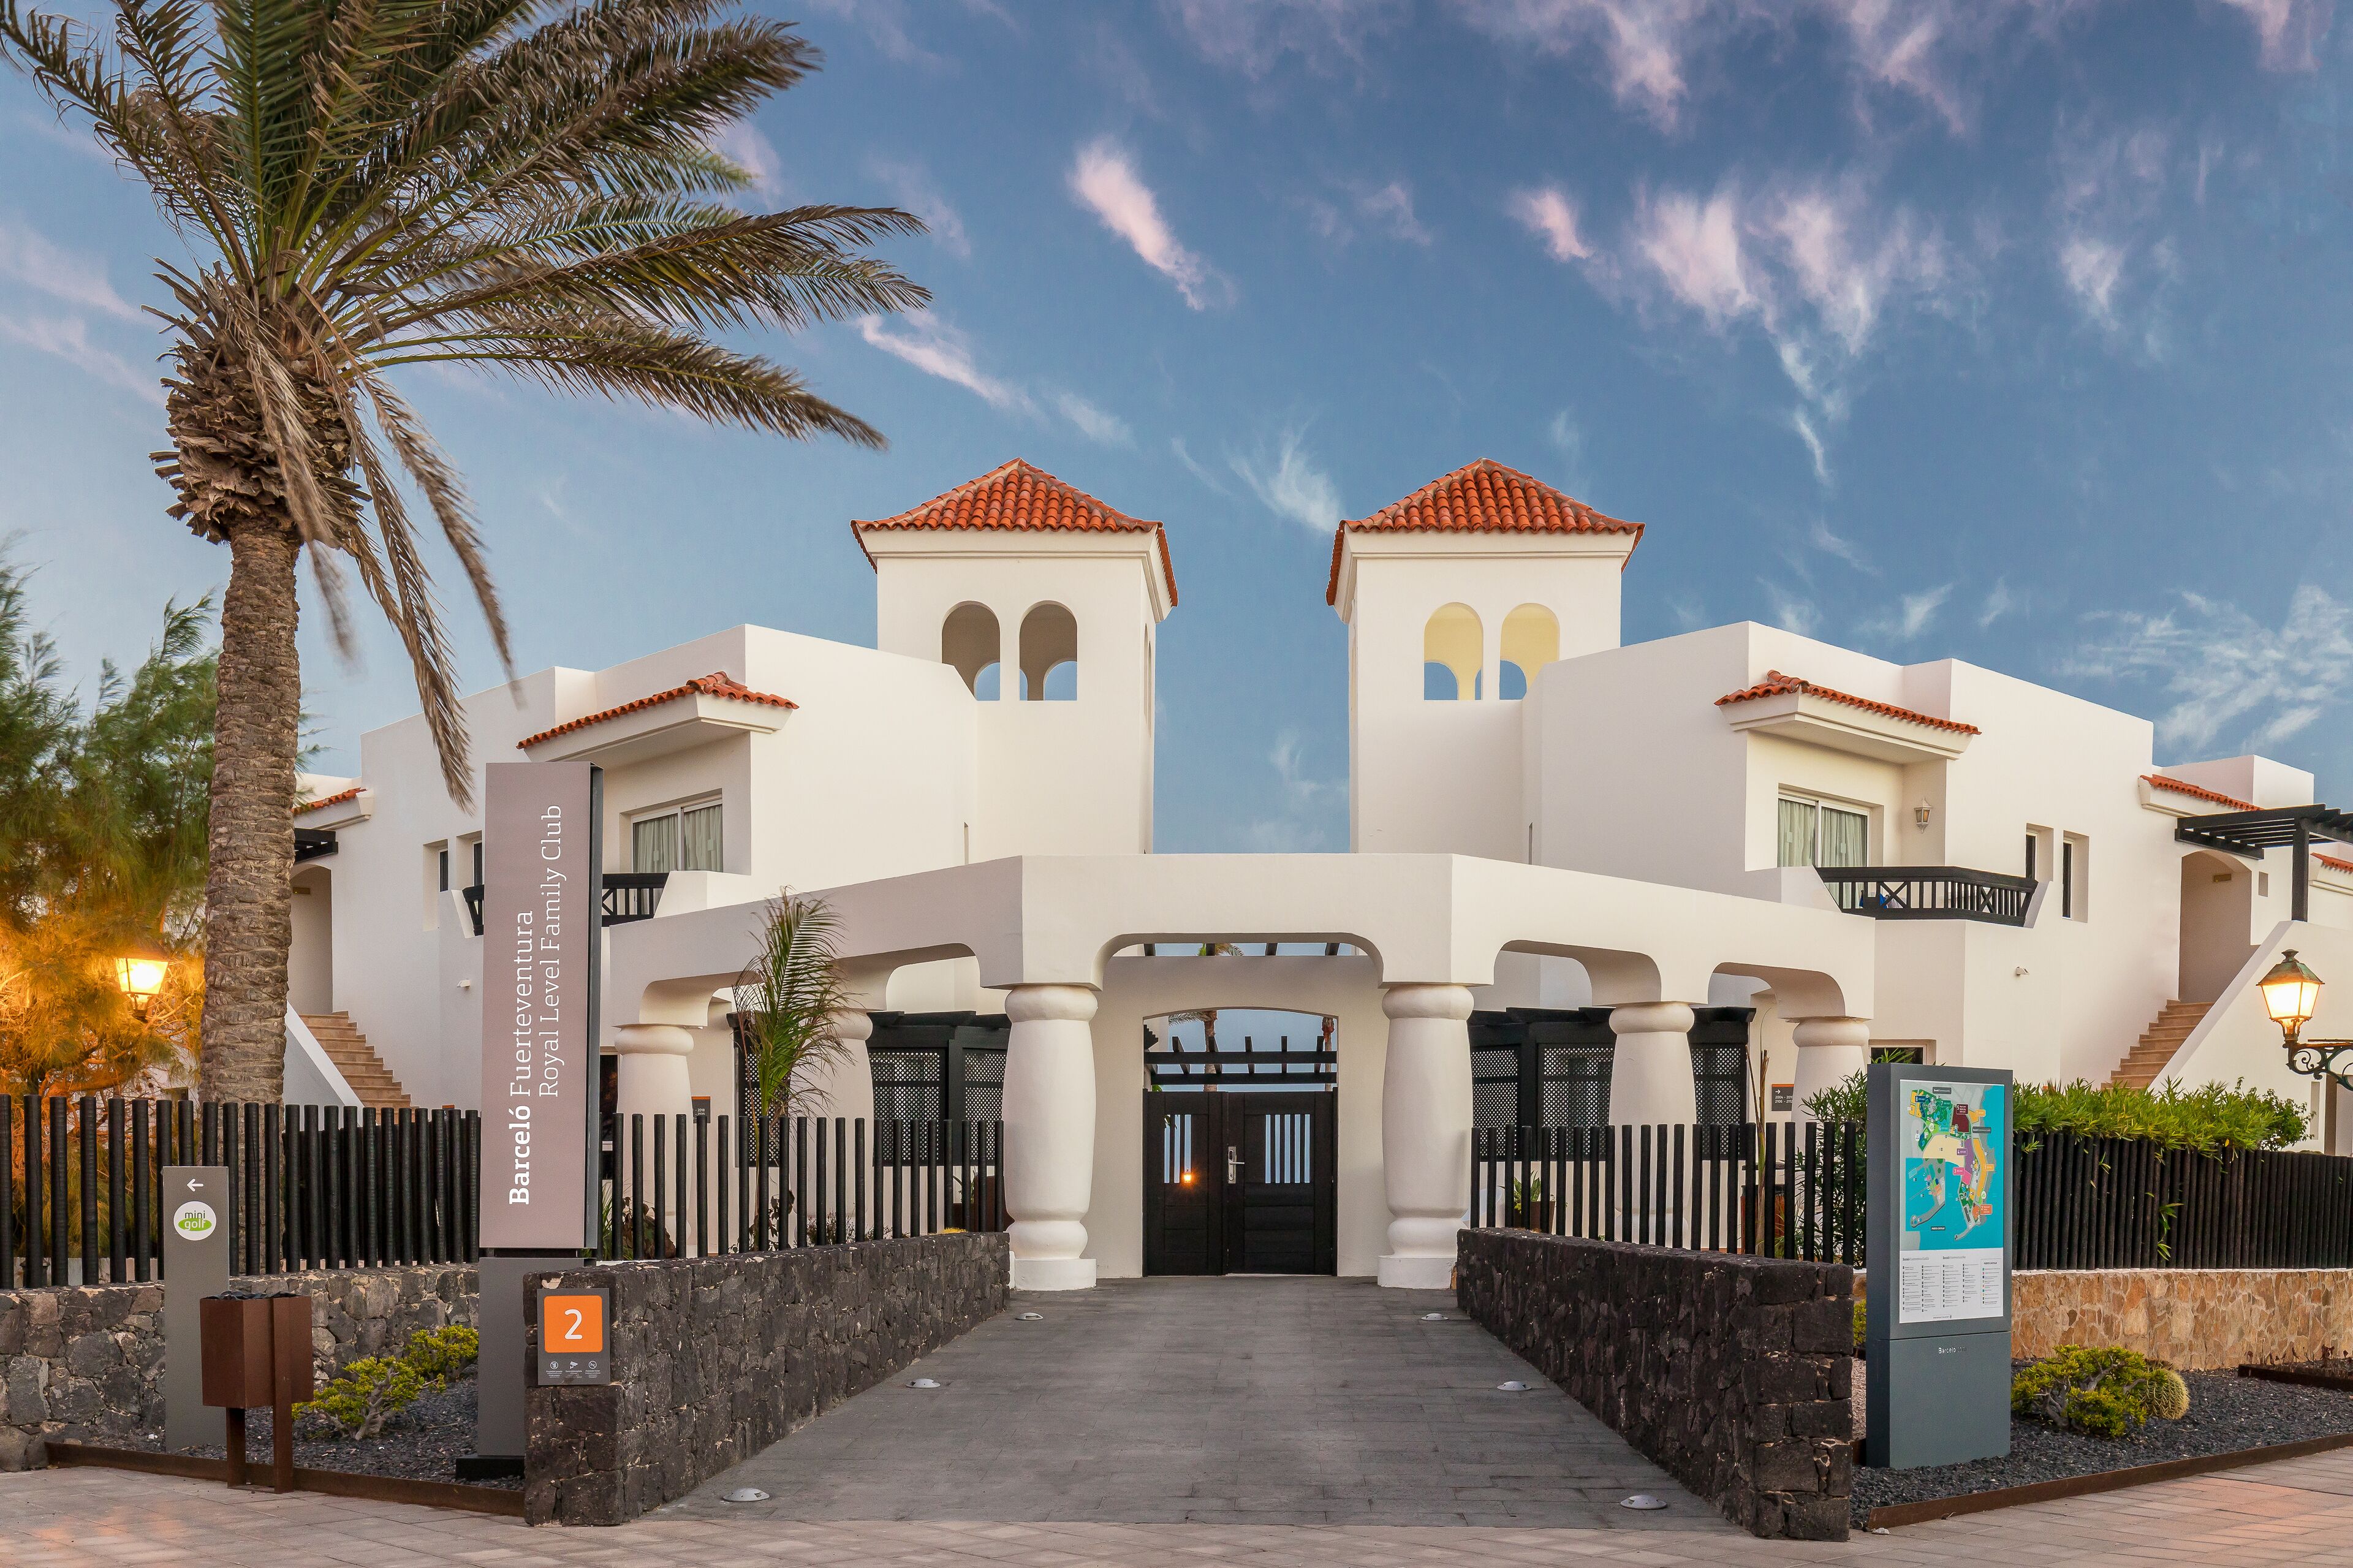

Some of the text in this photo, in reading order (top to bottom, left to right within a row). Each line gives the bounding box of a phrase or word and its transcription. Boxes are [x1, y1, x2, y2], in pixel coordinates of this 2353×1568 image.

[539, 805, 567, 1097] Royal Level Family Club
[508, 911, 533, 1205] Barceló Fuerteventura
[184, 1210, 205, 1219] mini
[184, 1219, 206, 1230] golf
[564, 1309, 583, 1339] 2
